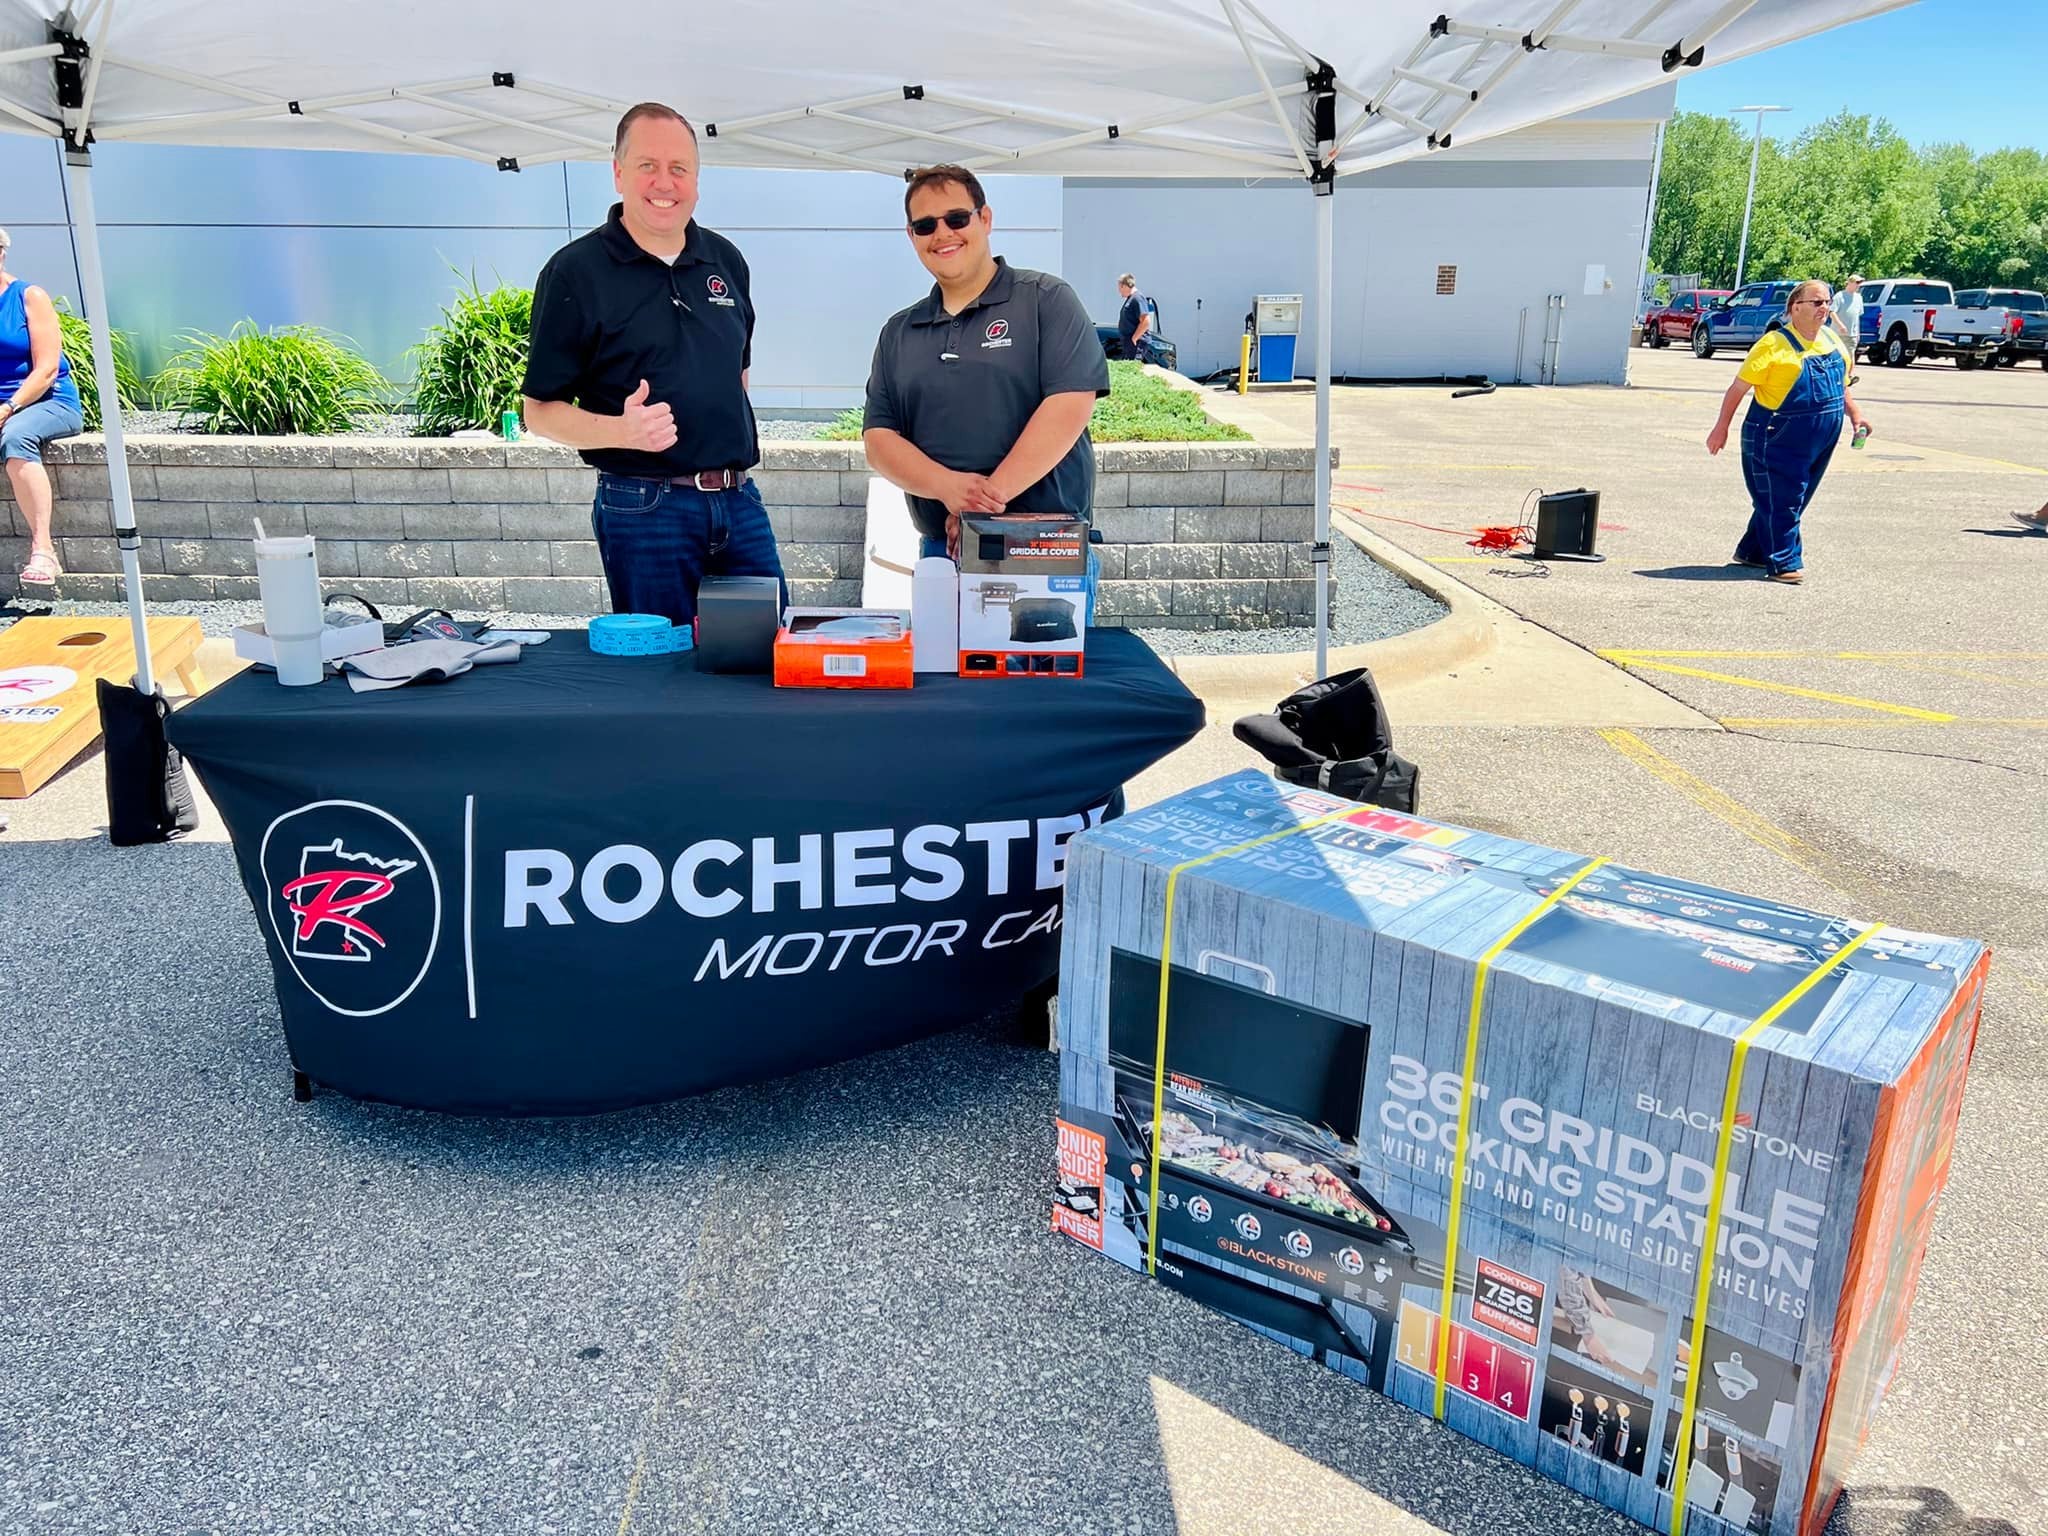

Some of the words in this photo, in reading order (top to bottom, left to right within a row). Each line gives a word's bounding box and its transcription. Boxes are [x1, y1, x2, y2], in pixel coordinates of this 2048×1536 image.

[1009, 547, 1048, 556] GRIDDLE
[1049, 547, 1080, 556] COVER
[502, 804, 1109, 928] ROCHESTE
[694, 918, 968, 983] MOTOR
[982, 904, 1063, 949] CA
[1058, 1127, 1101, 1162] ONUS
[1385, 1054, 1490, 1116] 36"
[1500, 1097, 1826, 1251] GRIDDLE
[1636, 1092, 1833, 1172] BLACKSTONE
[1057, 1146, 1101, 1183] SIDE!
[1379, 1100, 1583, 1199] COOKING
[1594, 1181, 1815, 1291] STATION
[1381, 1133, 1426, 1169] WITH
[1434, 1154, 1486, 1190] HOOD
[1493, 1178, 1533, 1211] AND
[1543, 1198, 1634, 1250] FOLDING
[1642, 1236, 1694, 1274] SIDE
[1060, 1215, 1100, 1245] INER
[1229, 1240, 1328, 1284] BLACKSTONE
[1484, 1266, 1538, 1293] COOKTOP
[1483, 1279, 1534, 1314] 756
[1480, 1305, 1532, 1335] SURFACE
[1403, 1343, 1413, 1361] 1
[1467, 1373, 1480, 1391] 3
[1500, 1391, 1514, 1408] 4
